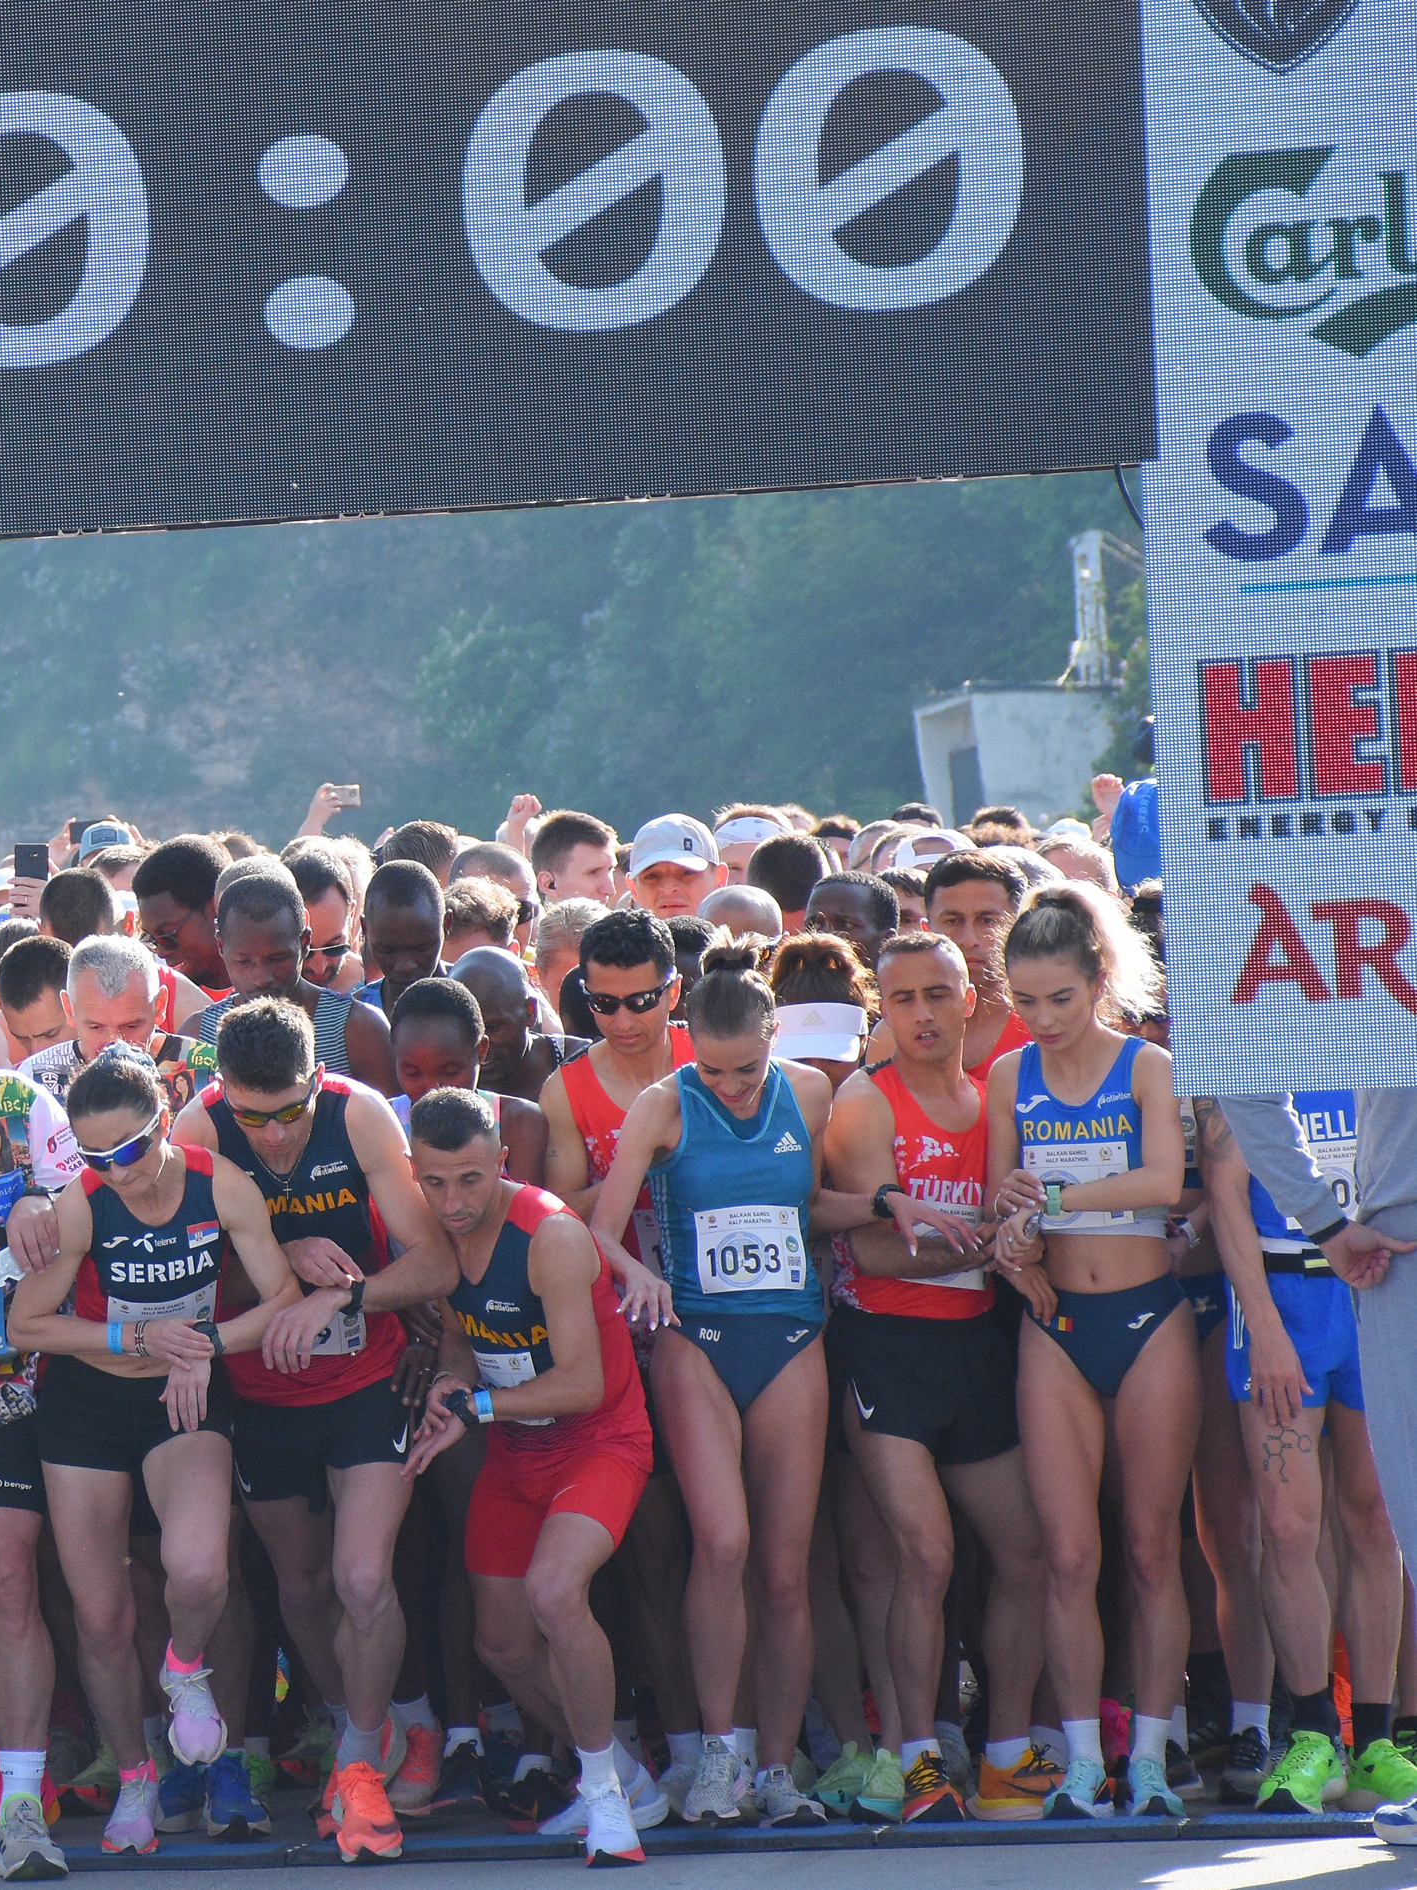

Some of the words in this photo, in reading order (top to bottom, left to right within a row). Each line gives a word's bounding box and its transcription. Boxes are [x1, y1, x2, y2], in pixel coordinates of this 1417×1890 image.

[1206, 807, 1387, 842] ENERGY
[1022, 1113, 1134, 1142] ROMANIA
[774, 1144, 803, 1154] adidas
[154, 1236, 178, 1247] telenor
[110, 1250, 215, 1284] SERBIA
[706, 1243, 782, 1277] 1053
[699, 1327, 722, 1342] ROU
